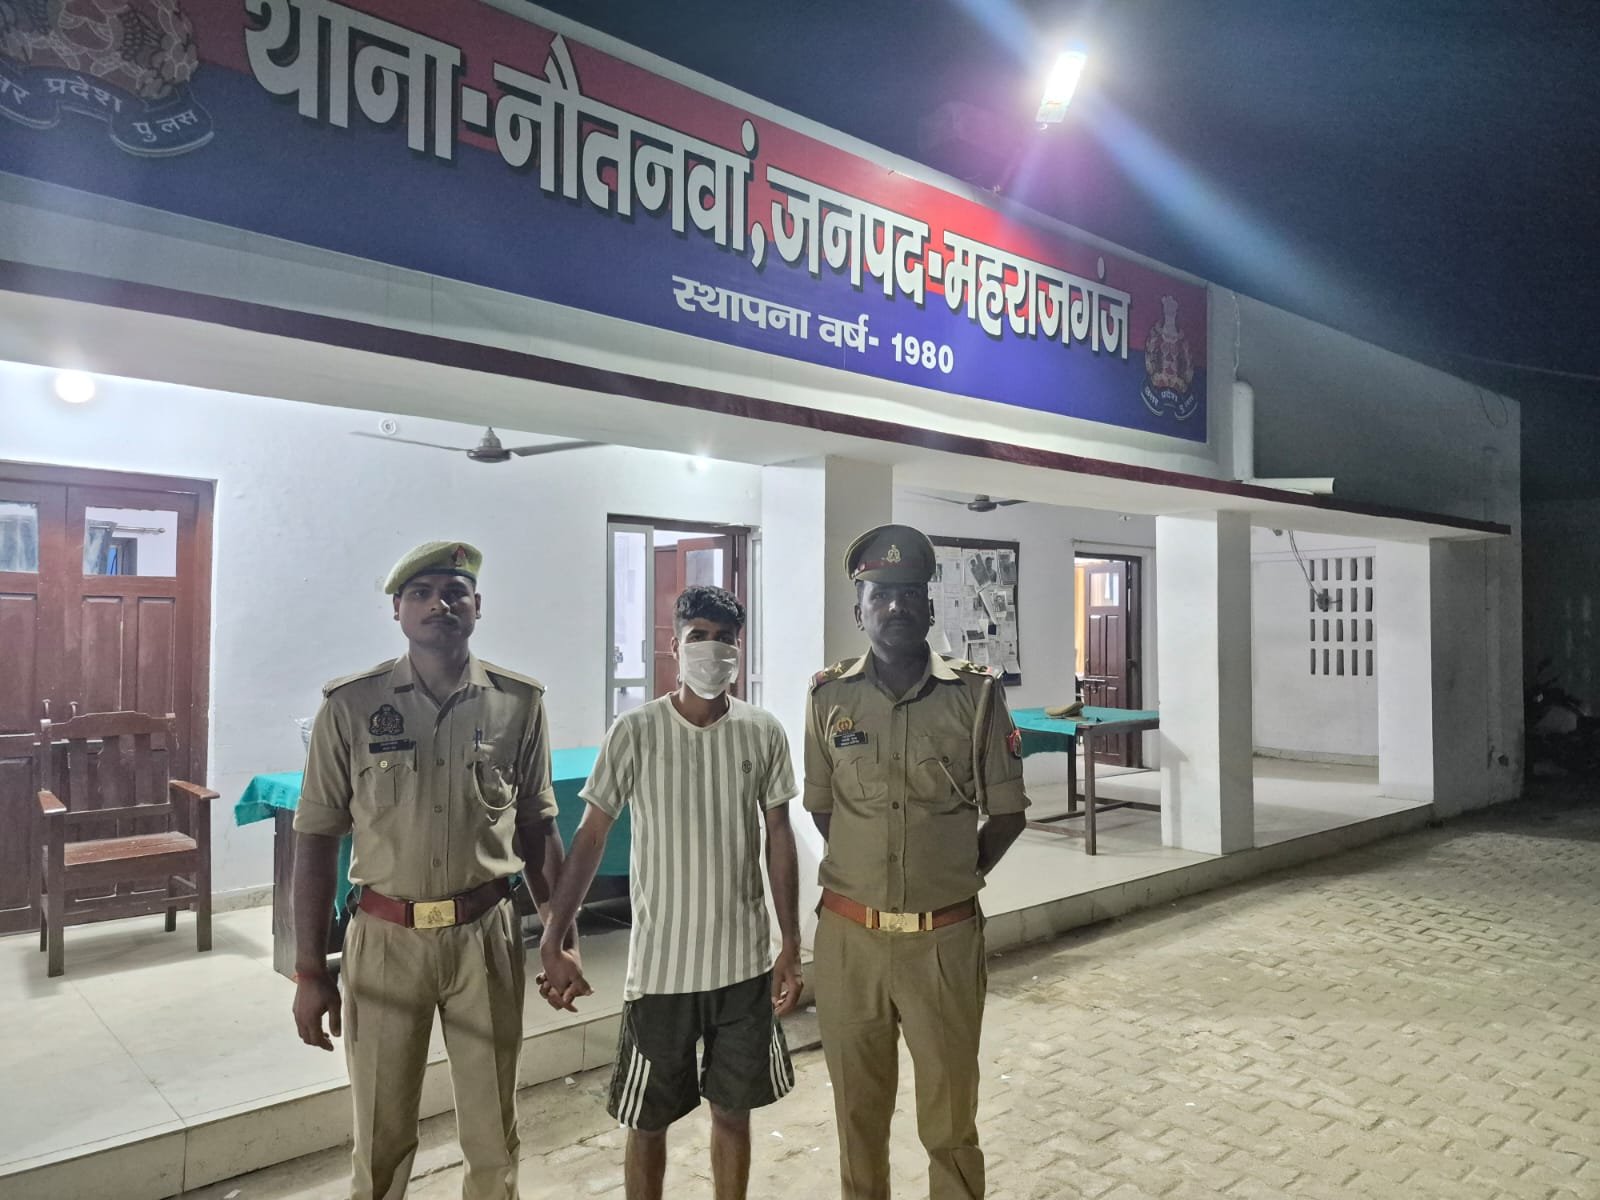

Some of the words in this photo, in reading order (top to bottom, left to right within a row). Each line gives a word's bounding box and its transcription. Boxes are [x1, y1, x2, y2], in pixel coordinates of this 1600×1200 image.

[43, 75, 123, 112] प्रदेश
[672, 275, 811, 339] स्थापना
[892, 333, 954, 374] 1980
